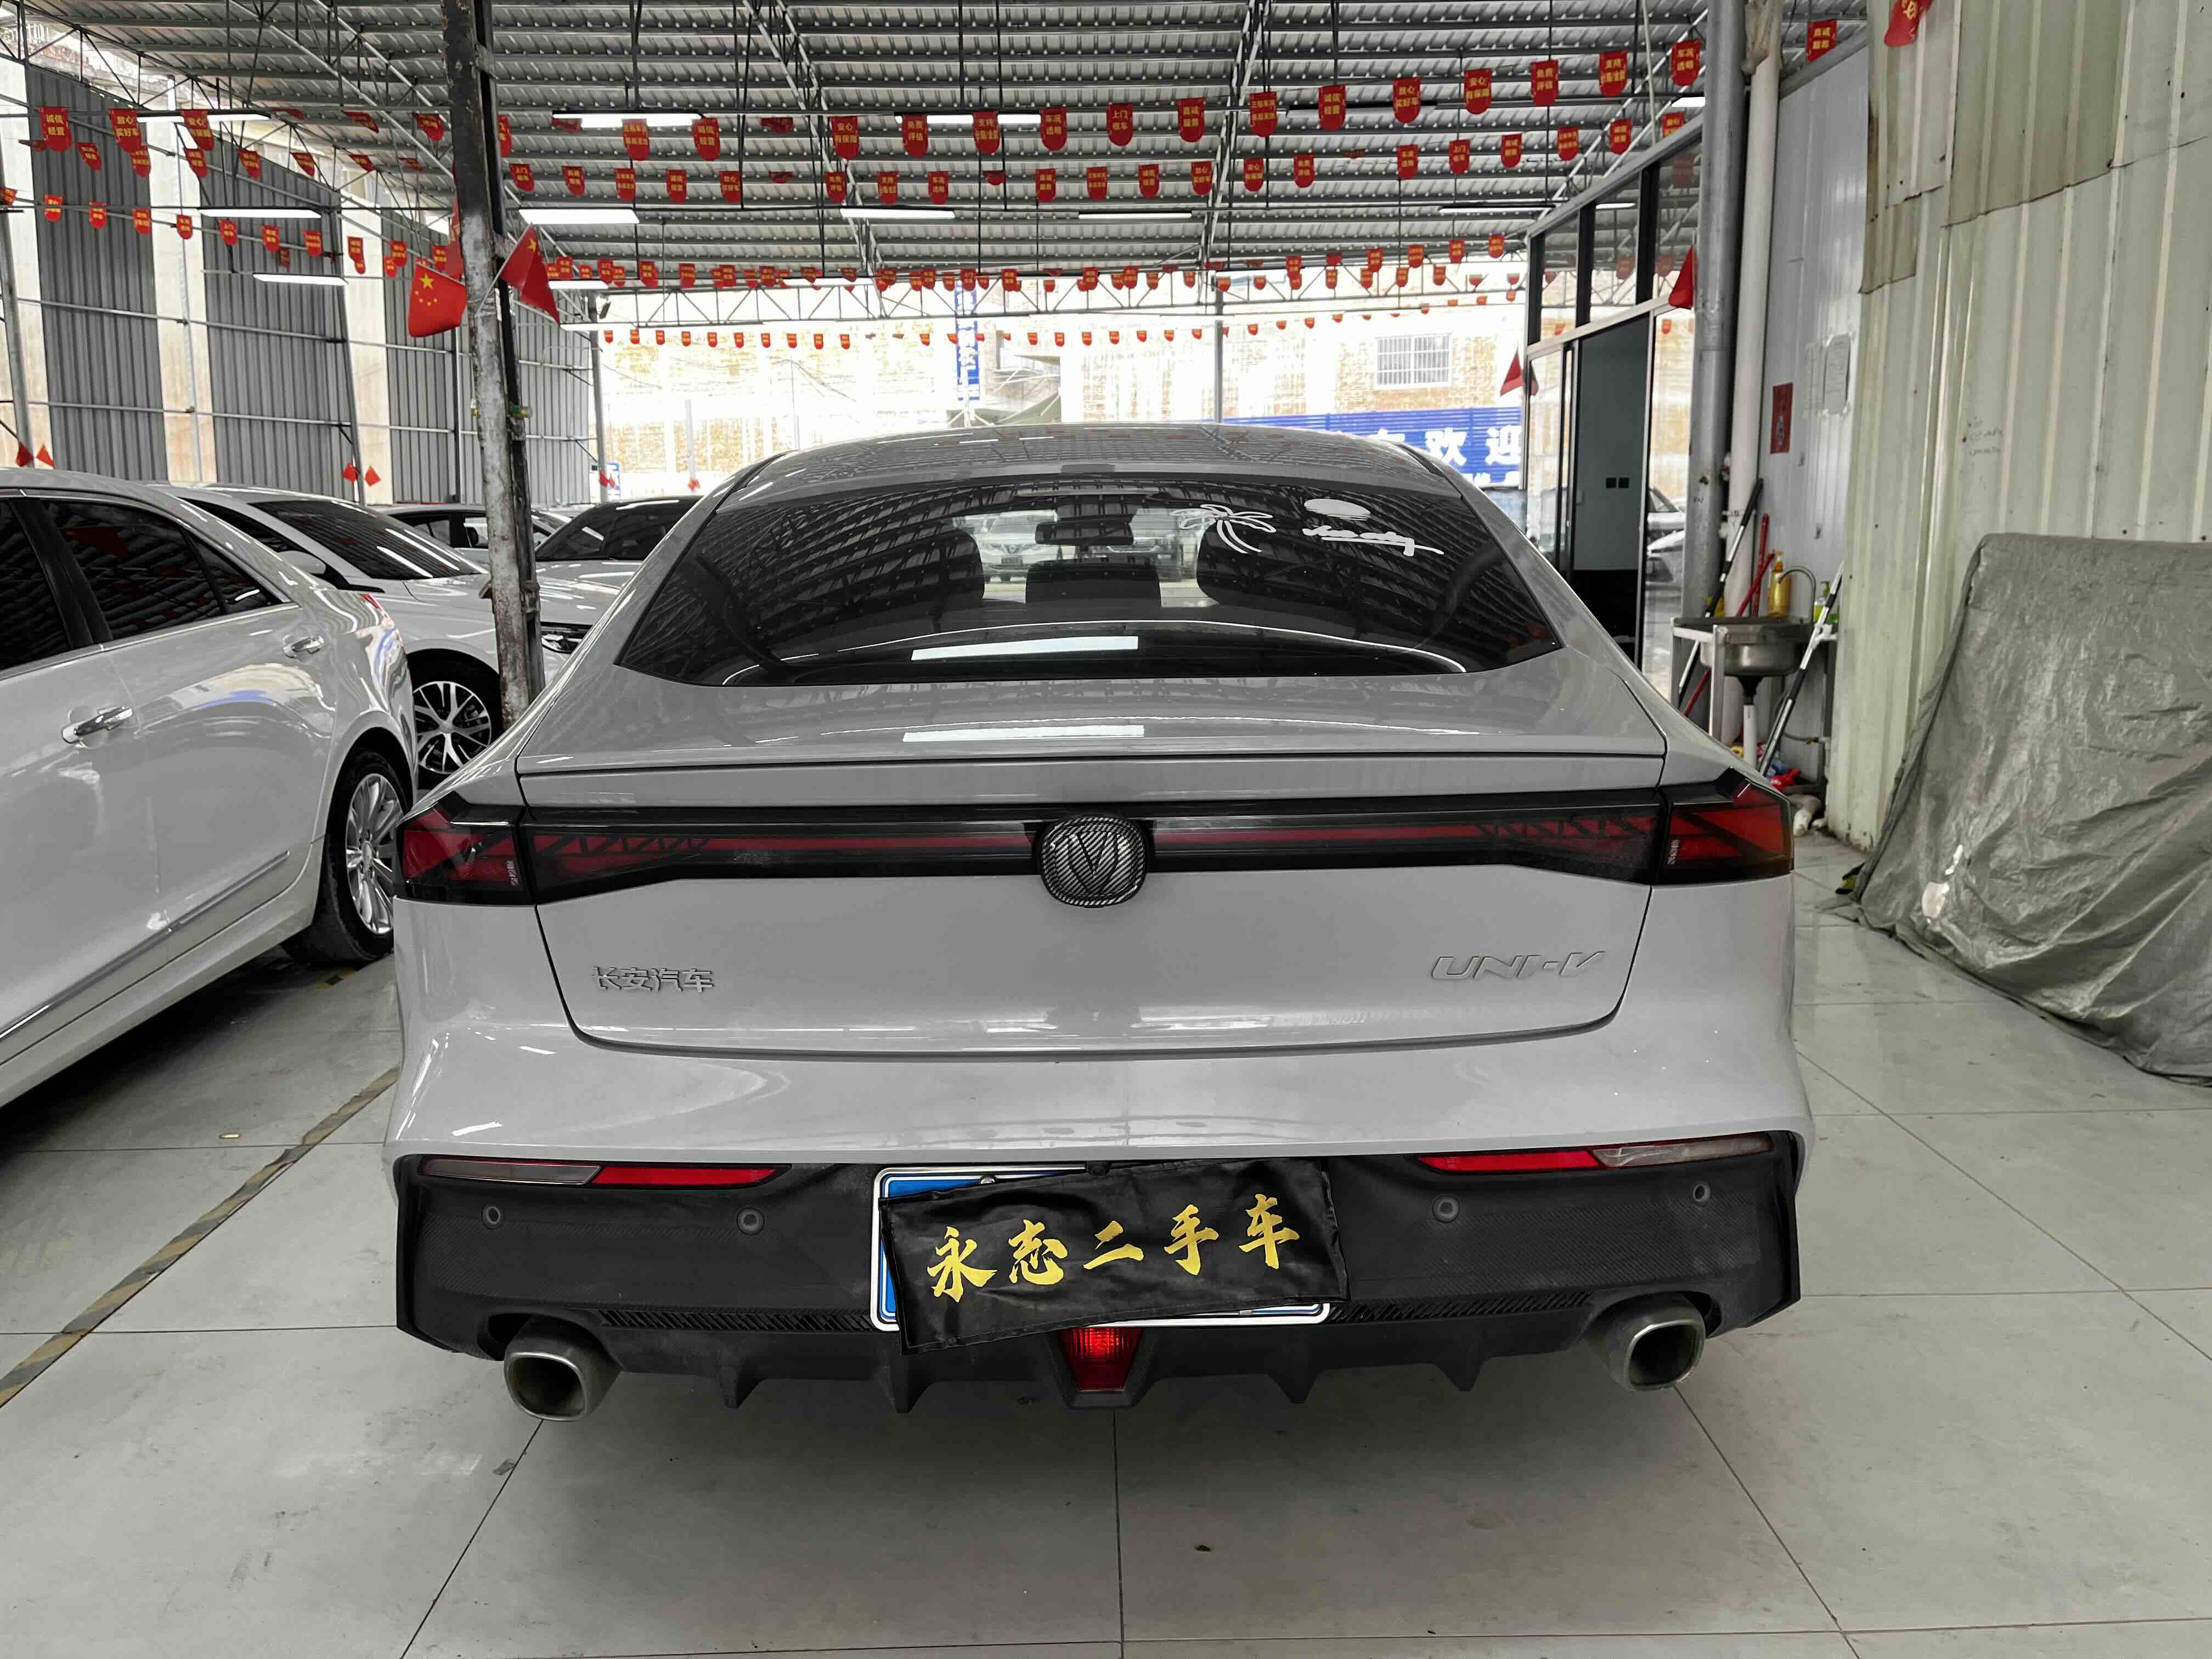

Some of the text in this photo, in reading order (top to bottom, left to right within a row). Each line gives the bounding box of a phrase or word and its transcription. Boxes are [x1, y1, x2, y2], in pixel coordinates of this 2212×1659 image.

[1112, 109, 1128, 119] 上门
[591, 965, 715, 993] 长安汽车
[1431, 951, 1606, 980] UNI-V
[926, 1193, 1301, 1304] 永志二手车
